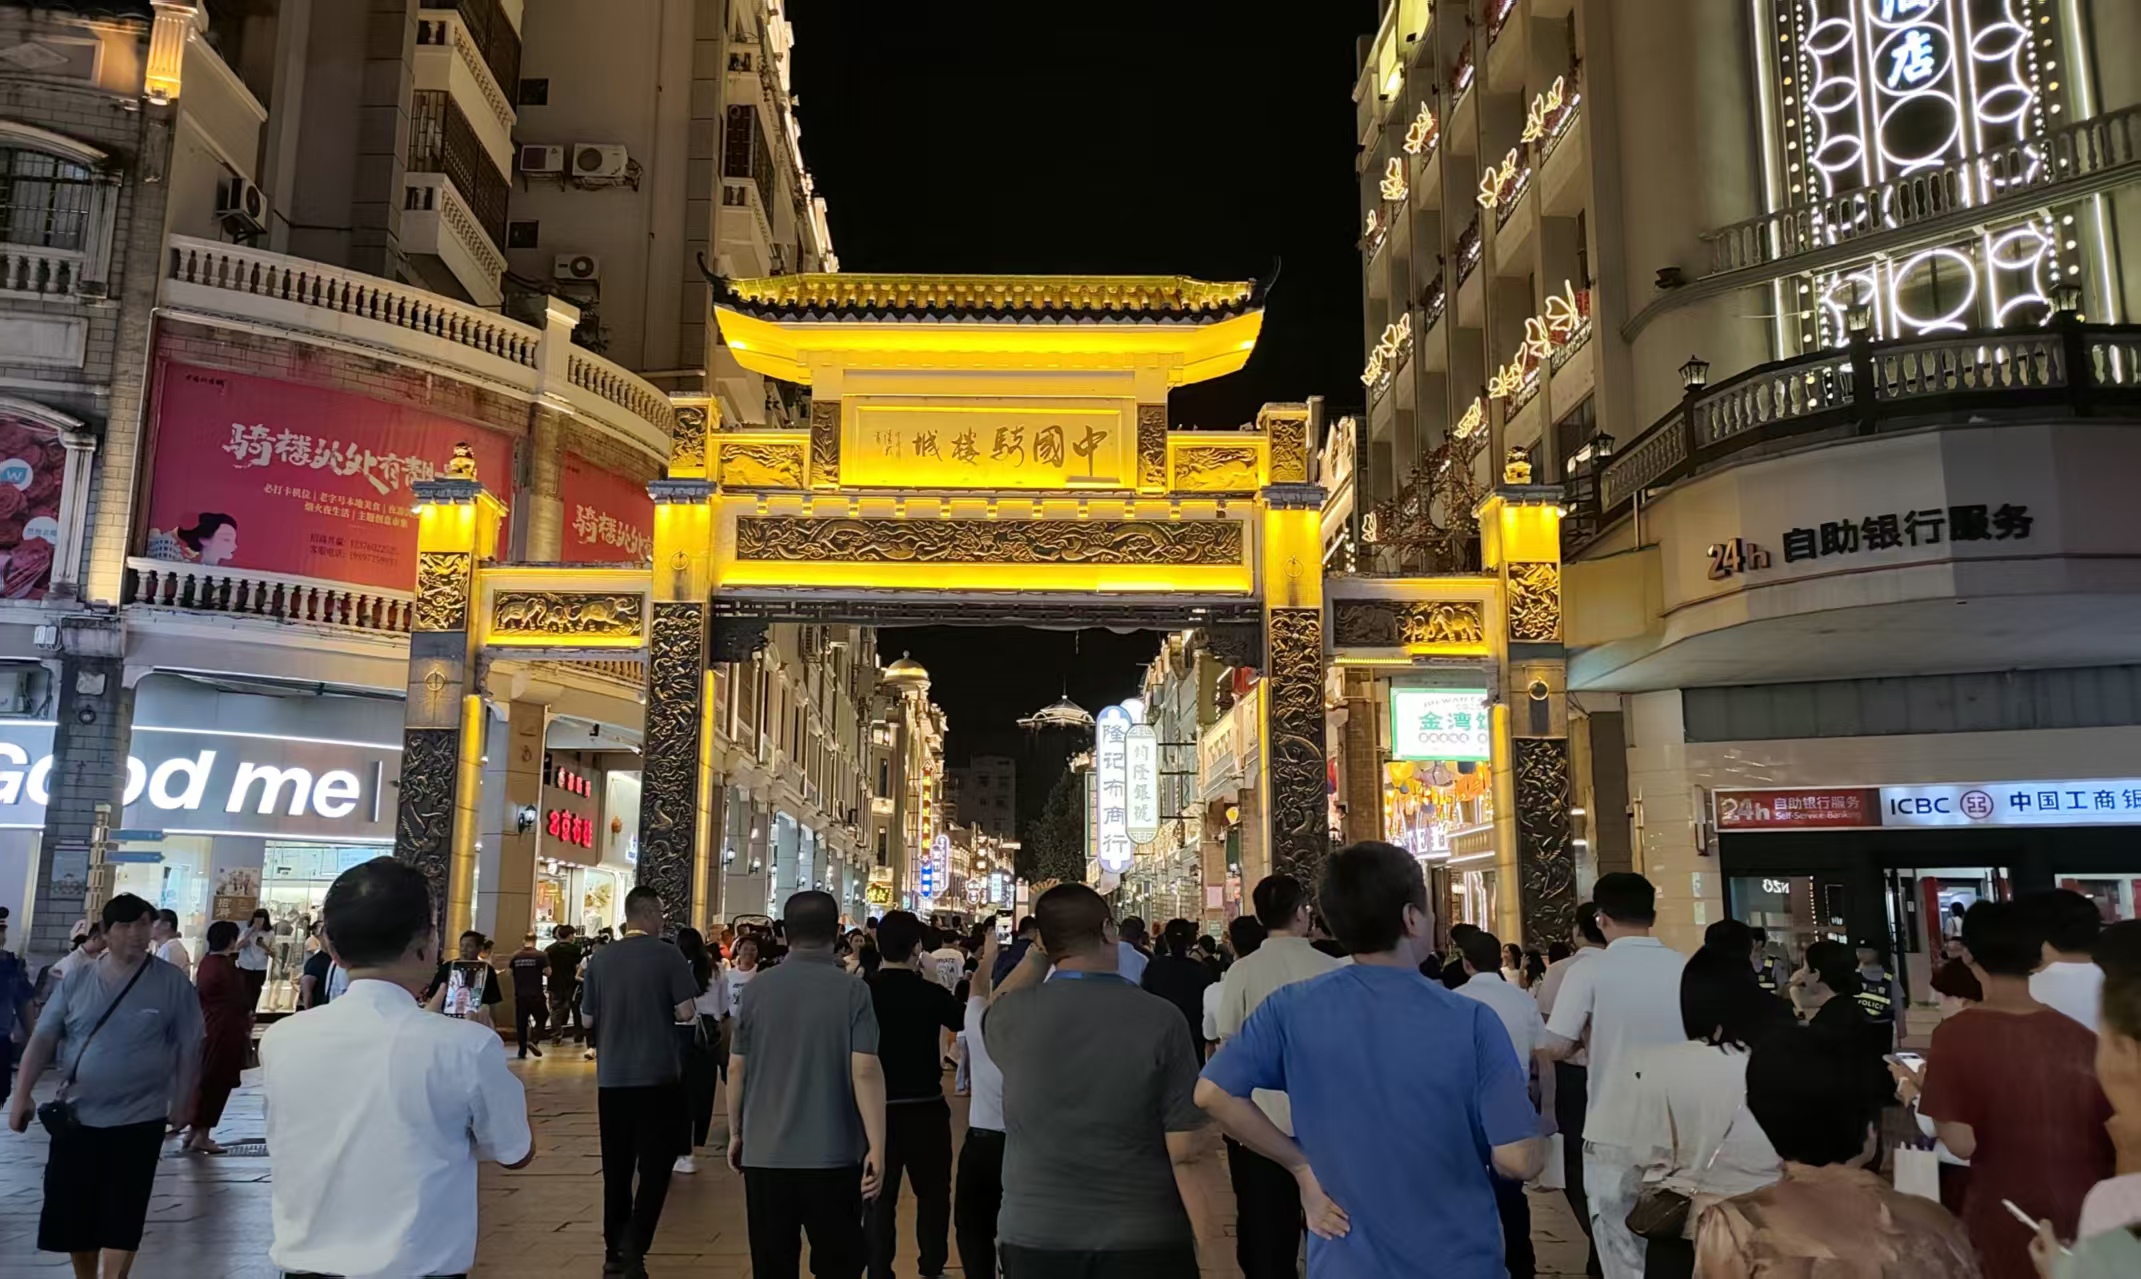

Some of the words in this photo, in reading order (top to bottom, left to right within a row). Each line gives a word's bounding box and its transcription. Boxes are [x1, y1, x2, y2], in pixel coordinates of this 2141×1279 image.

[1706, 537, 1771, 580] 24h
[1782, 502, 2035, 564] 自助银行服务
[225, 761, 361, 819] me
[1101, 724, 1128, 854] 隆记布商行
[1774, 796, 1861, 811] 自助银行服务
[1890, 797, 1951, 815] ICBC
